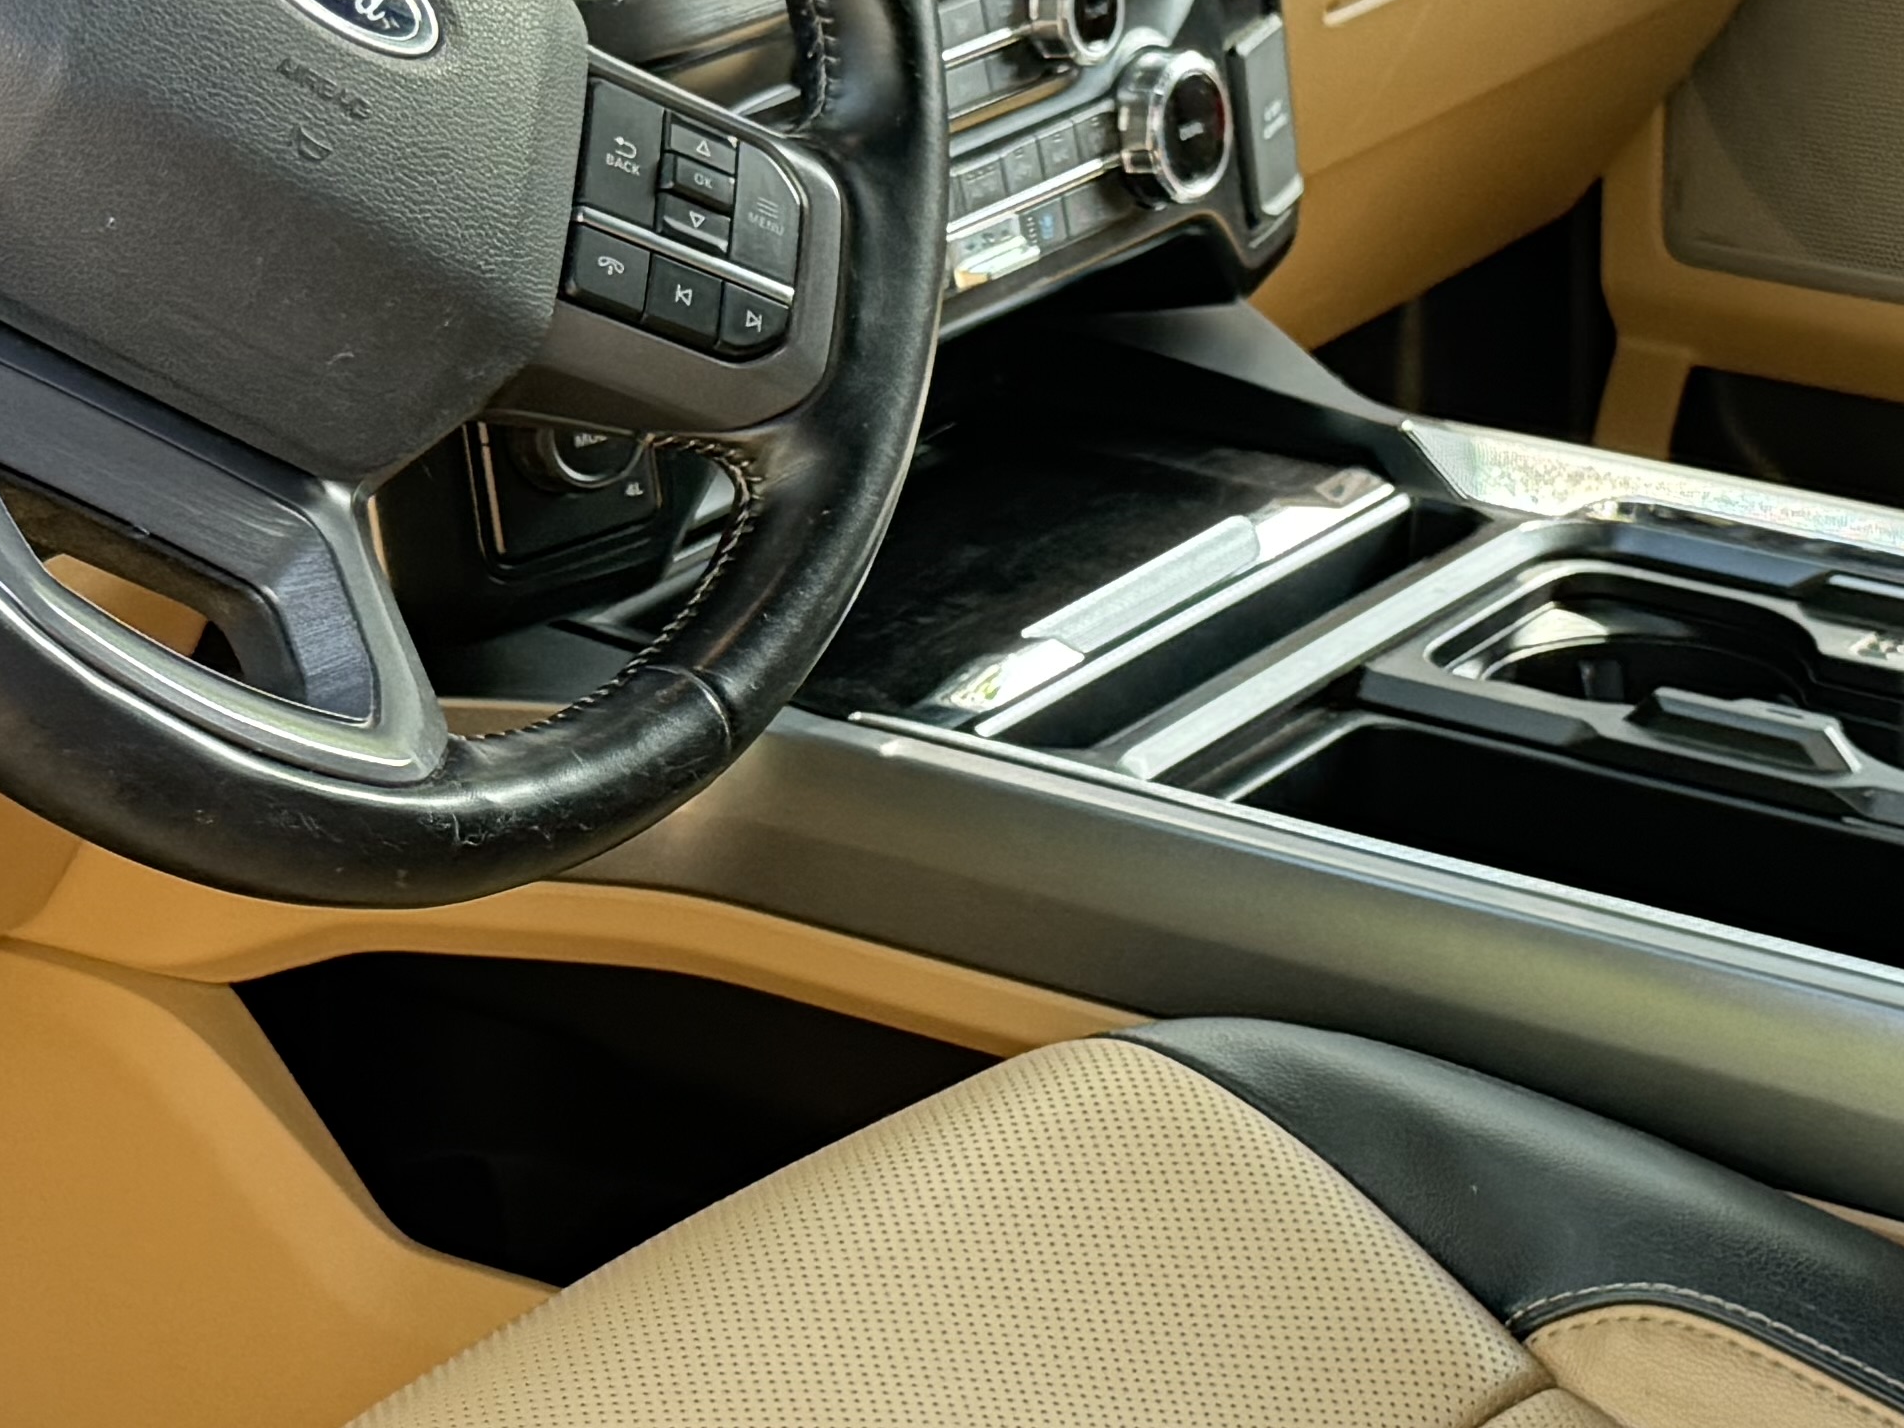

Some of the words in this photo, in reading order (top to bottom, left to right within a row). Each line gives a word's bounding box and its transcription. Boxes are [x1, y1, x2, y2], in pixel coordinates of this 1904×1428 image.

[605, 152, 641, 176] BACK
[694, 172, 712, 189] OK
[748, 211, 784, 236] MENU
